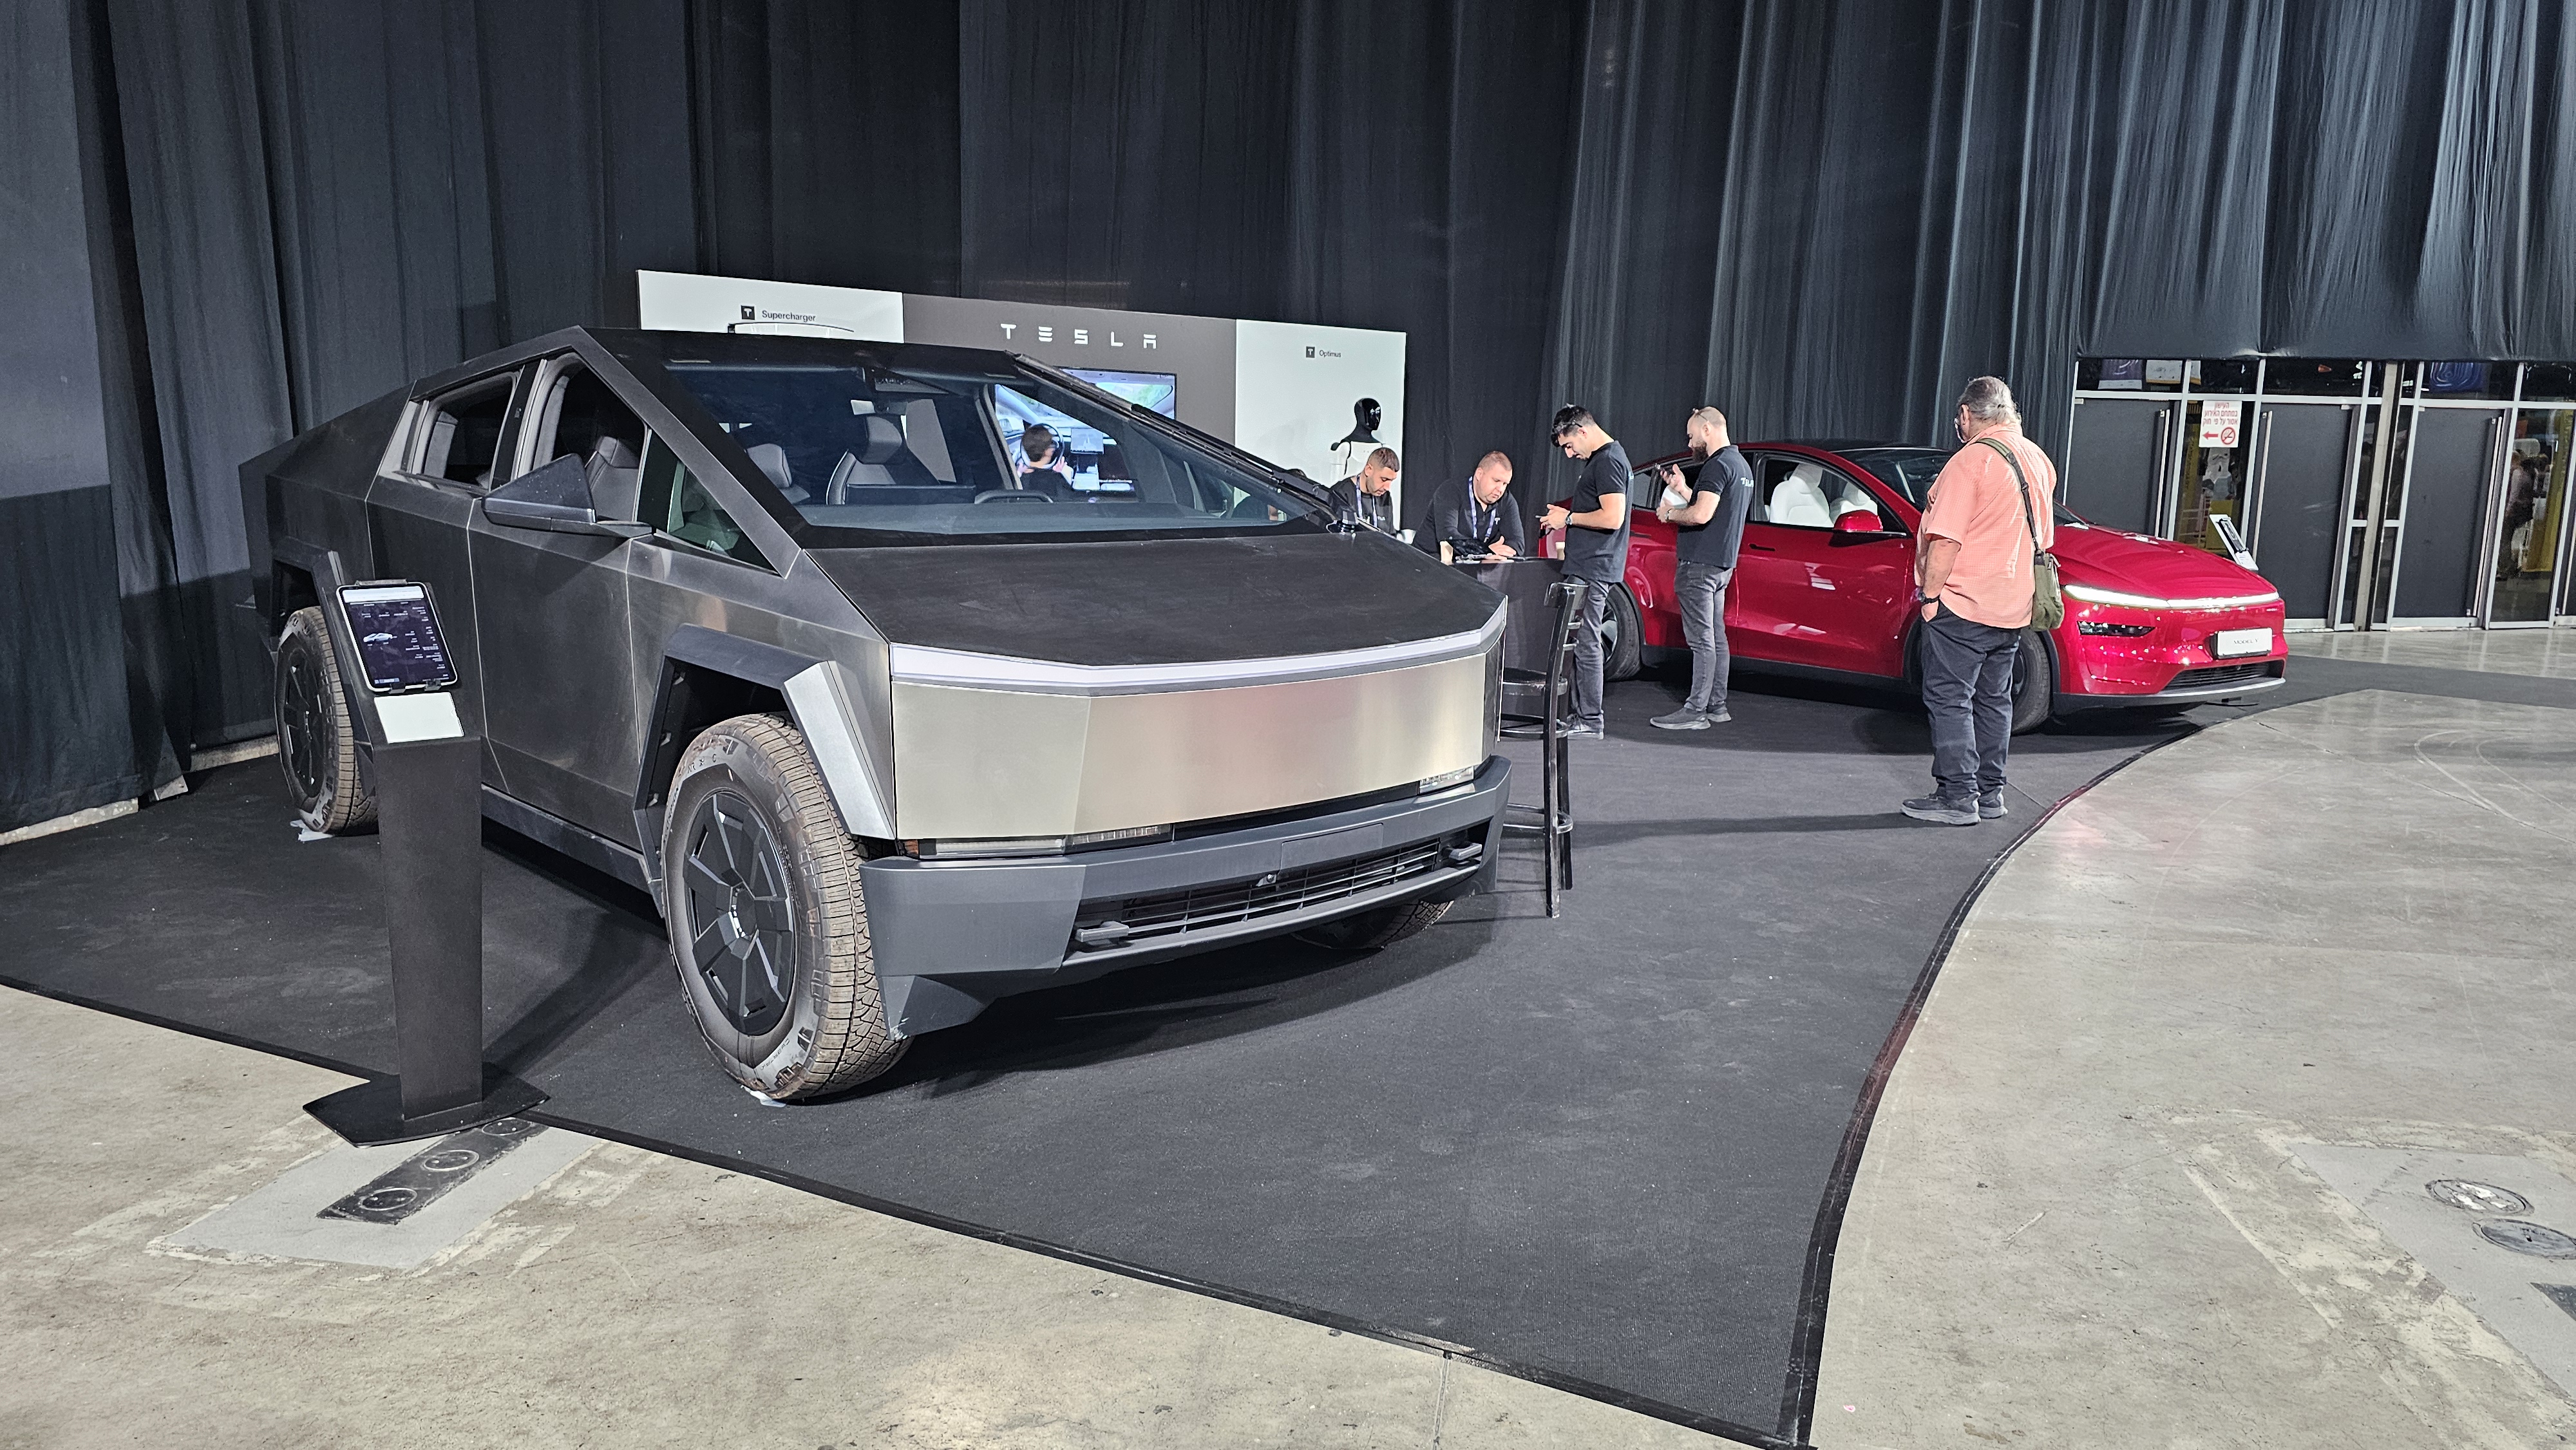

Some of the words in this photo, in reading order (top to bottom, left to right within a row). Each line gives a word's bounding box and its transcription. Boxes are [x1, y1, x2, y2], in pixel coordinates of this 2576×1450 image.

[762, 310, 816, 323] Supercharger
[1000, 323, 1157, 349] TESLA
[1319, 350, 1341, 358] Optimus
